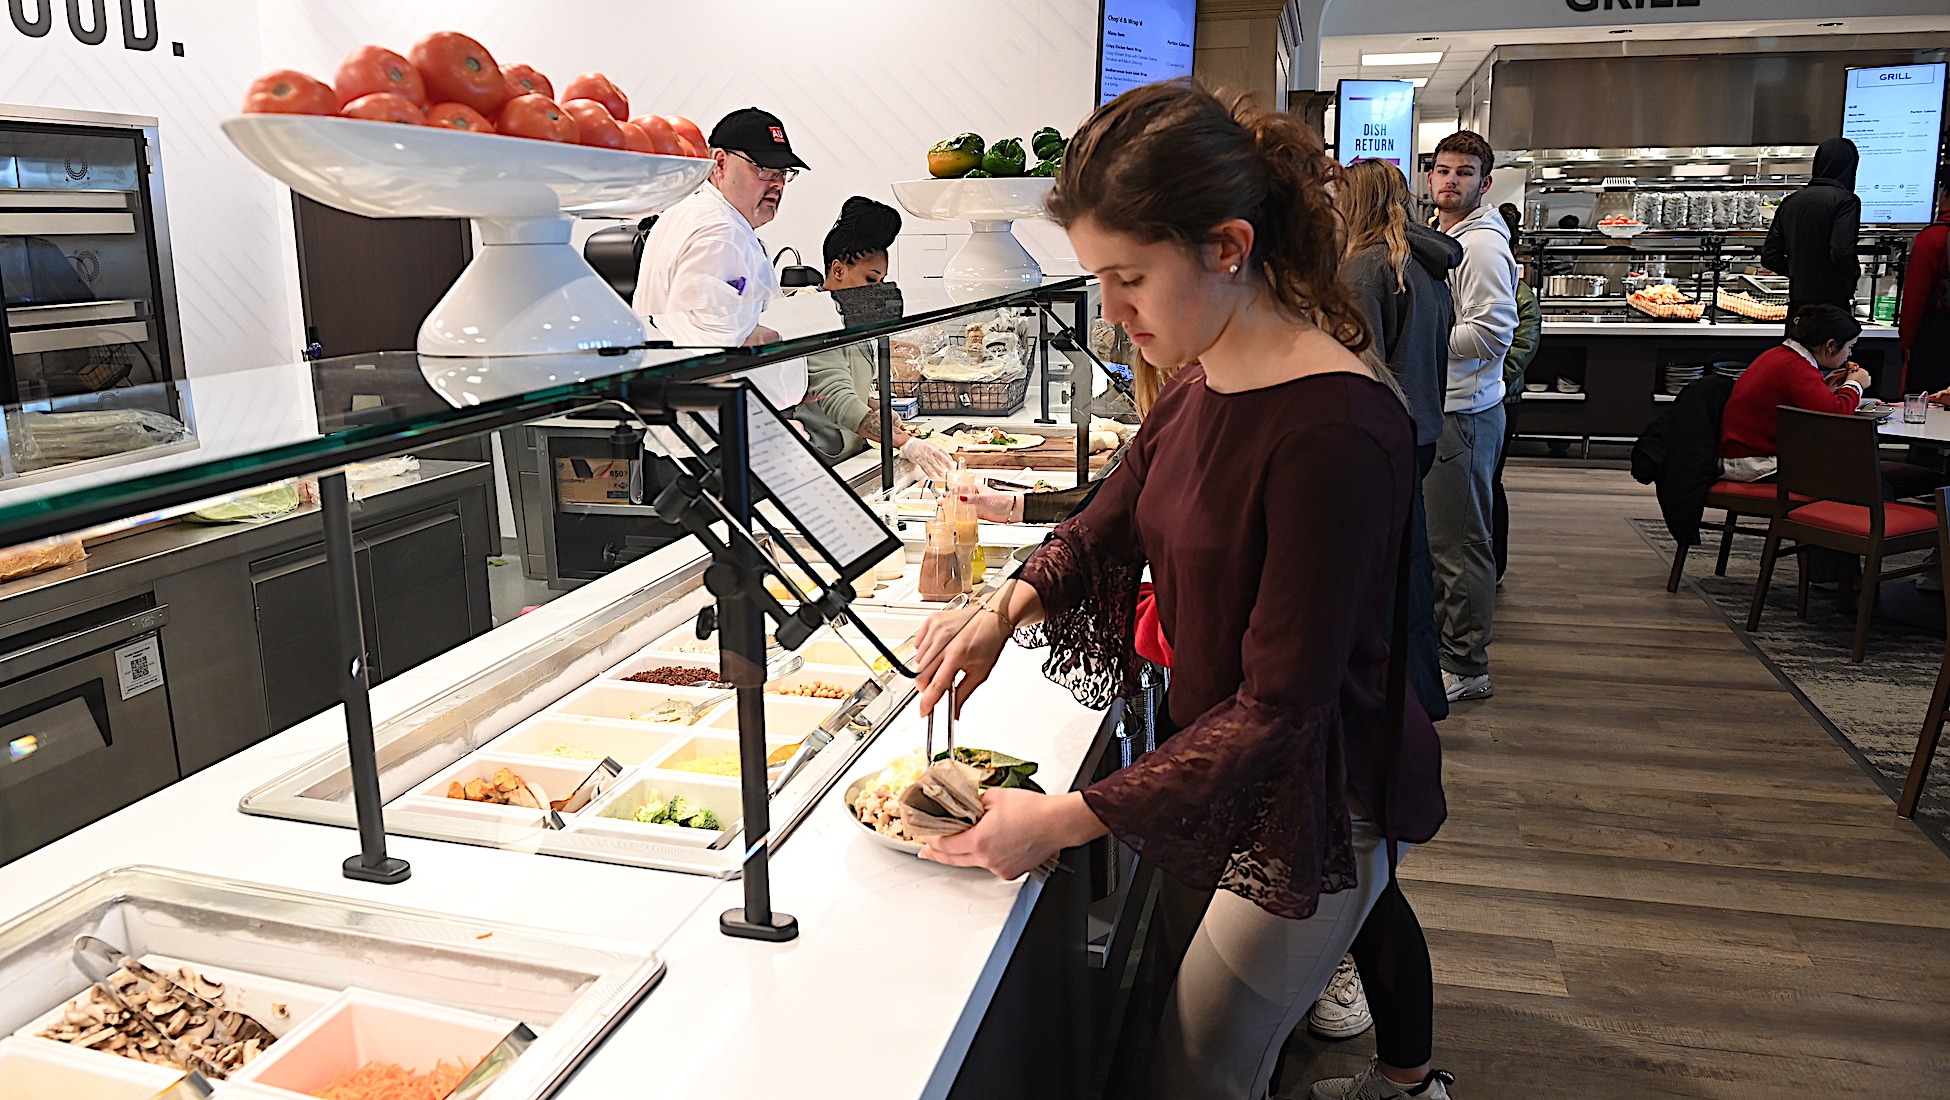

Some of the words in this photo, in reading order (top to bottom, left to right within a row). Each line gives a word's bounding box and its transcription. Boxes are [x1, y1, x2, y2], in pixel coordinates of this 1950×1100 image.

[1108, 14, 1122, 24] Chop'd
[1128, 18, 1142, 26] Wrap'd
[1880, 72, 1912, 81] GRILL
[1364, 124, 1386, 136] DISH
[1355, 138, 1394, 151] RETURN
